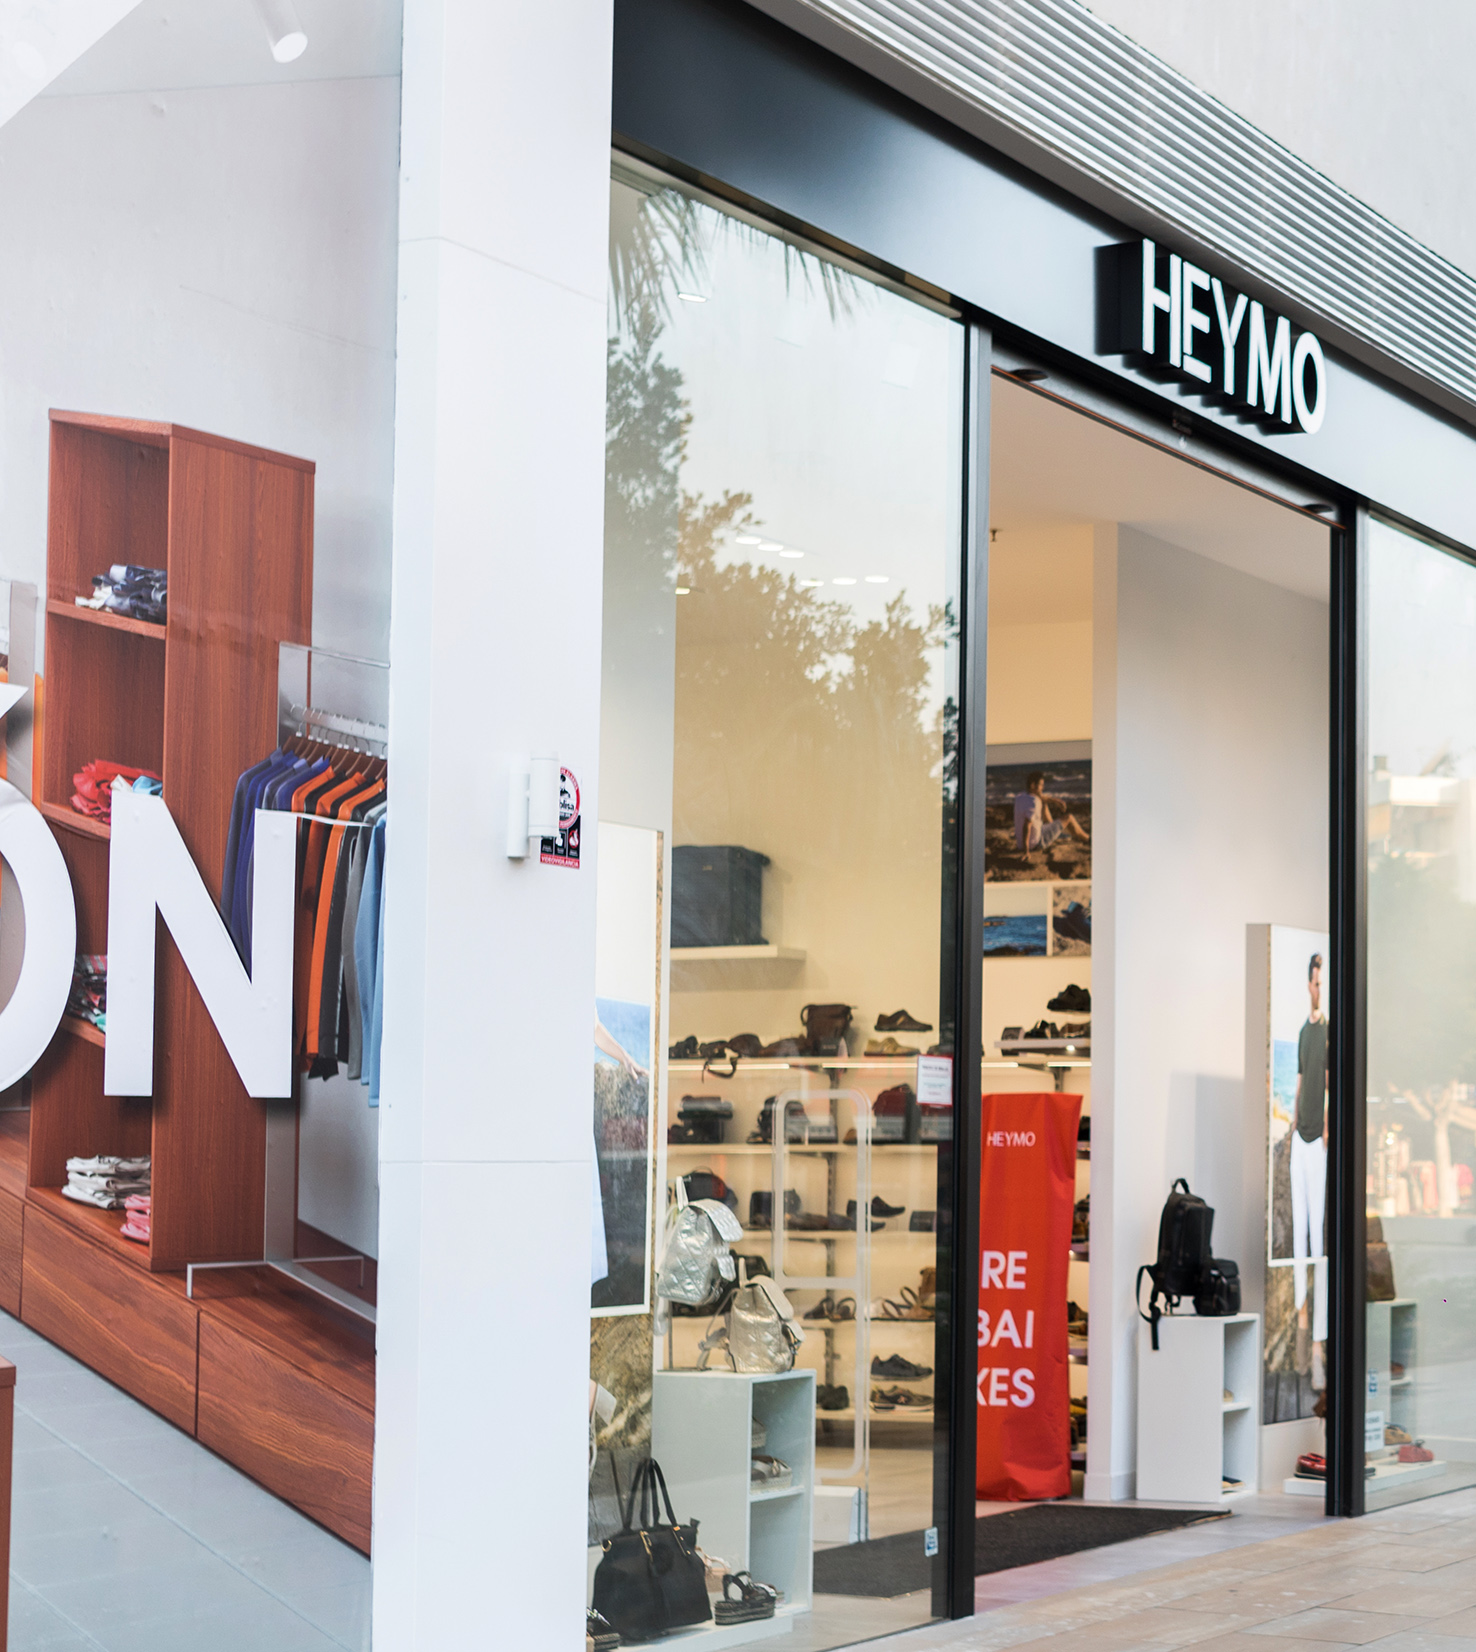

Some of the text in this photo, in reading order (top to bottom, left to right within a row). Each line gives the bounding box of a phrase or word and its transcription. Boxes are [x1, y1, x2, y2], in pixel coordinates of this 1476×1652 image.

[1142, 238, 1326, 435] HEYMO
[986, 1131, 1036, 1147] HEYMO
[981, 1250, 1028, 1289] RE
[977, 1309, 1034, 1348] BAI
